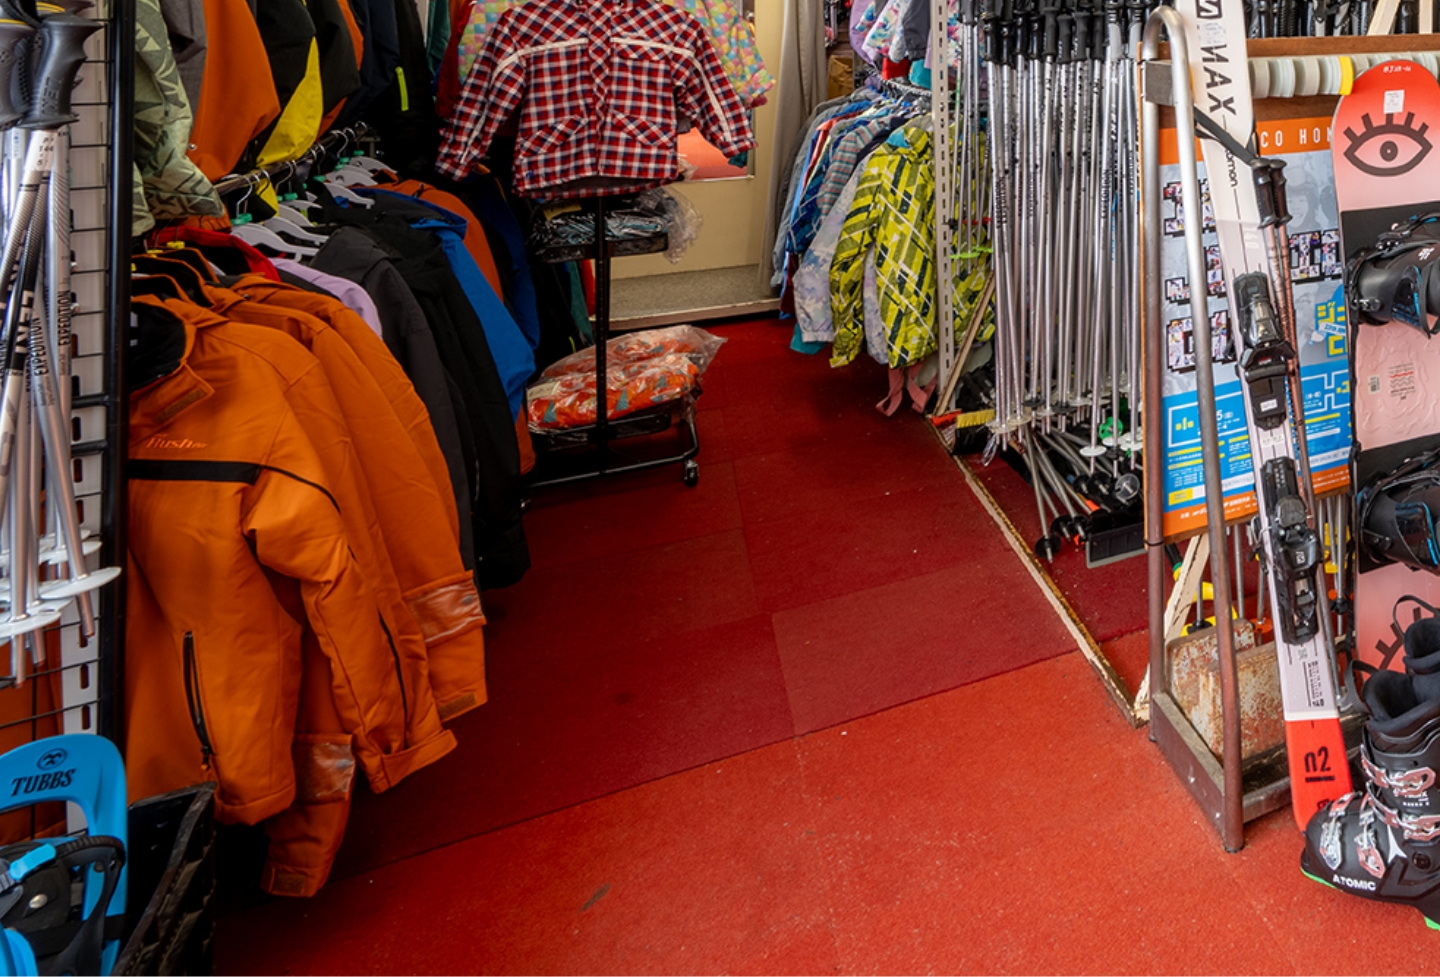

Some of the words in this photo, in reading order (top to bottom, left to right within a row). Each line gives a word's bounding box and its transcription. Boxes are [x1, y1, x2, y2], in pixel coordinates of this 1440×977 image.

[57, 290, 71, 346] EXPEDITION
[31, 317, 49, 376] EXPEDITION
[10, 768, 77, 797] TUBBS
[1333, 874, 1377, 891] ATOMIC
